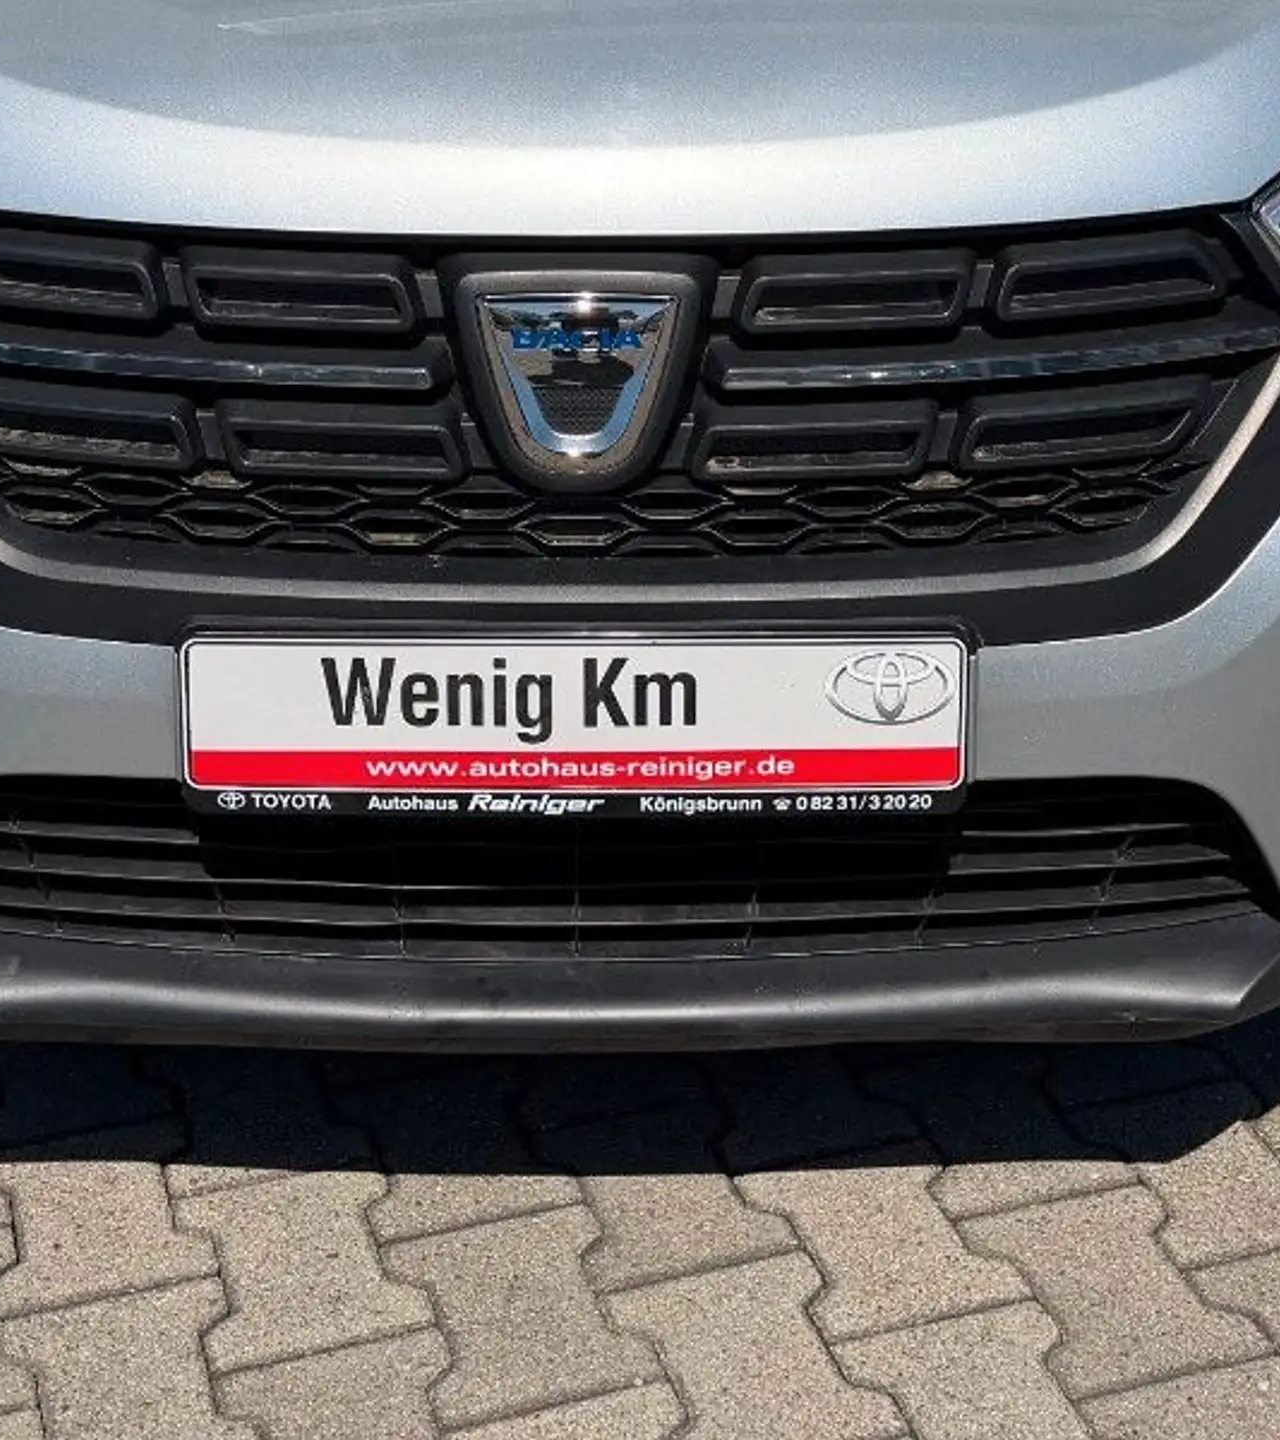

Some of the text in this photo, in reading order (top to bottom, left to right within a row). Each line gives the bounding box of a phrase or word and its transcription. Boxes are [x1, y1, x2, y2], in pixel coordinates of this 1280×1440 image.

[320, 656, 698, 745] Wenig Km
[365, 756, 795, 782] www.autohaus-reiniger.de
[251, 793, 332, 811] TOYOTA
[368, 793, 460, 811] Autohaus
[467, 793, 606, 816] Reiniger
[638, 795, 763, 816] Königsbrunn
